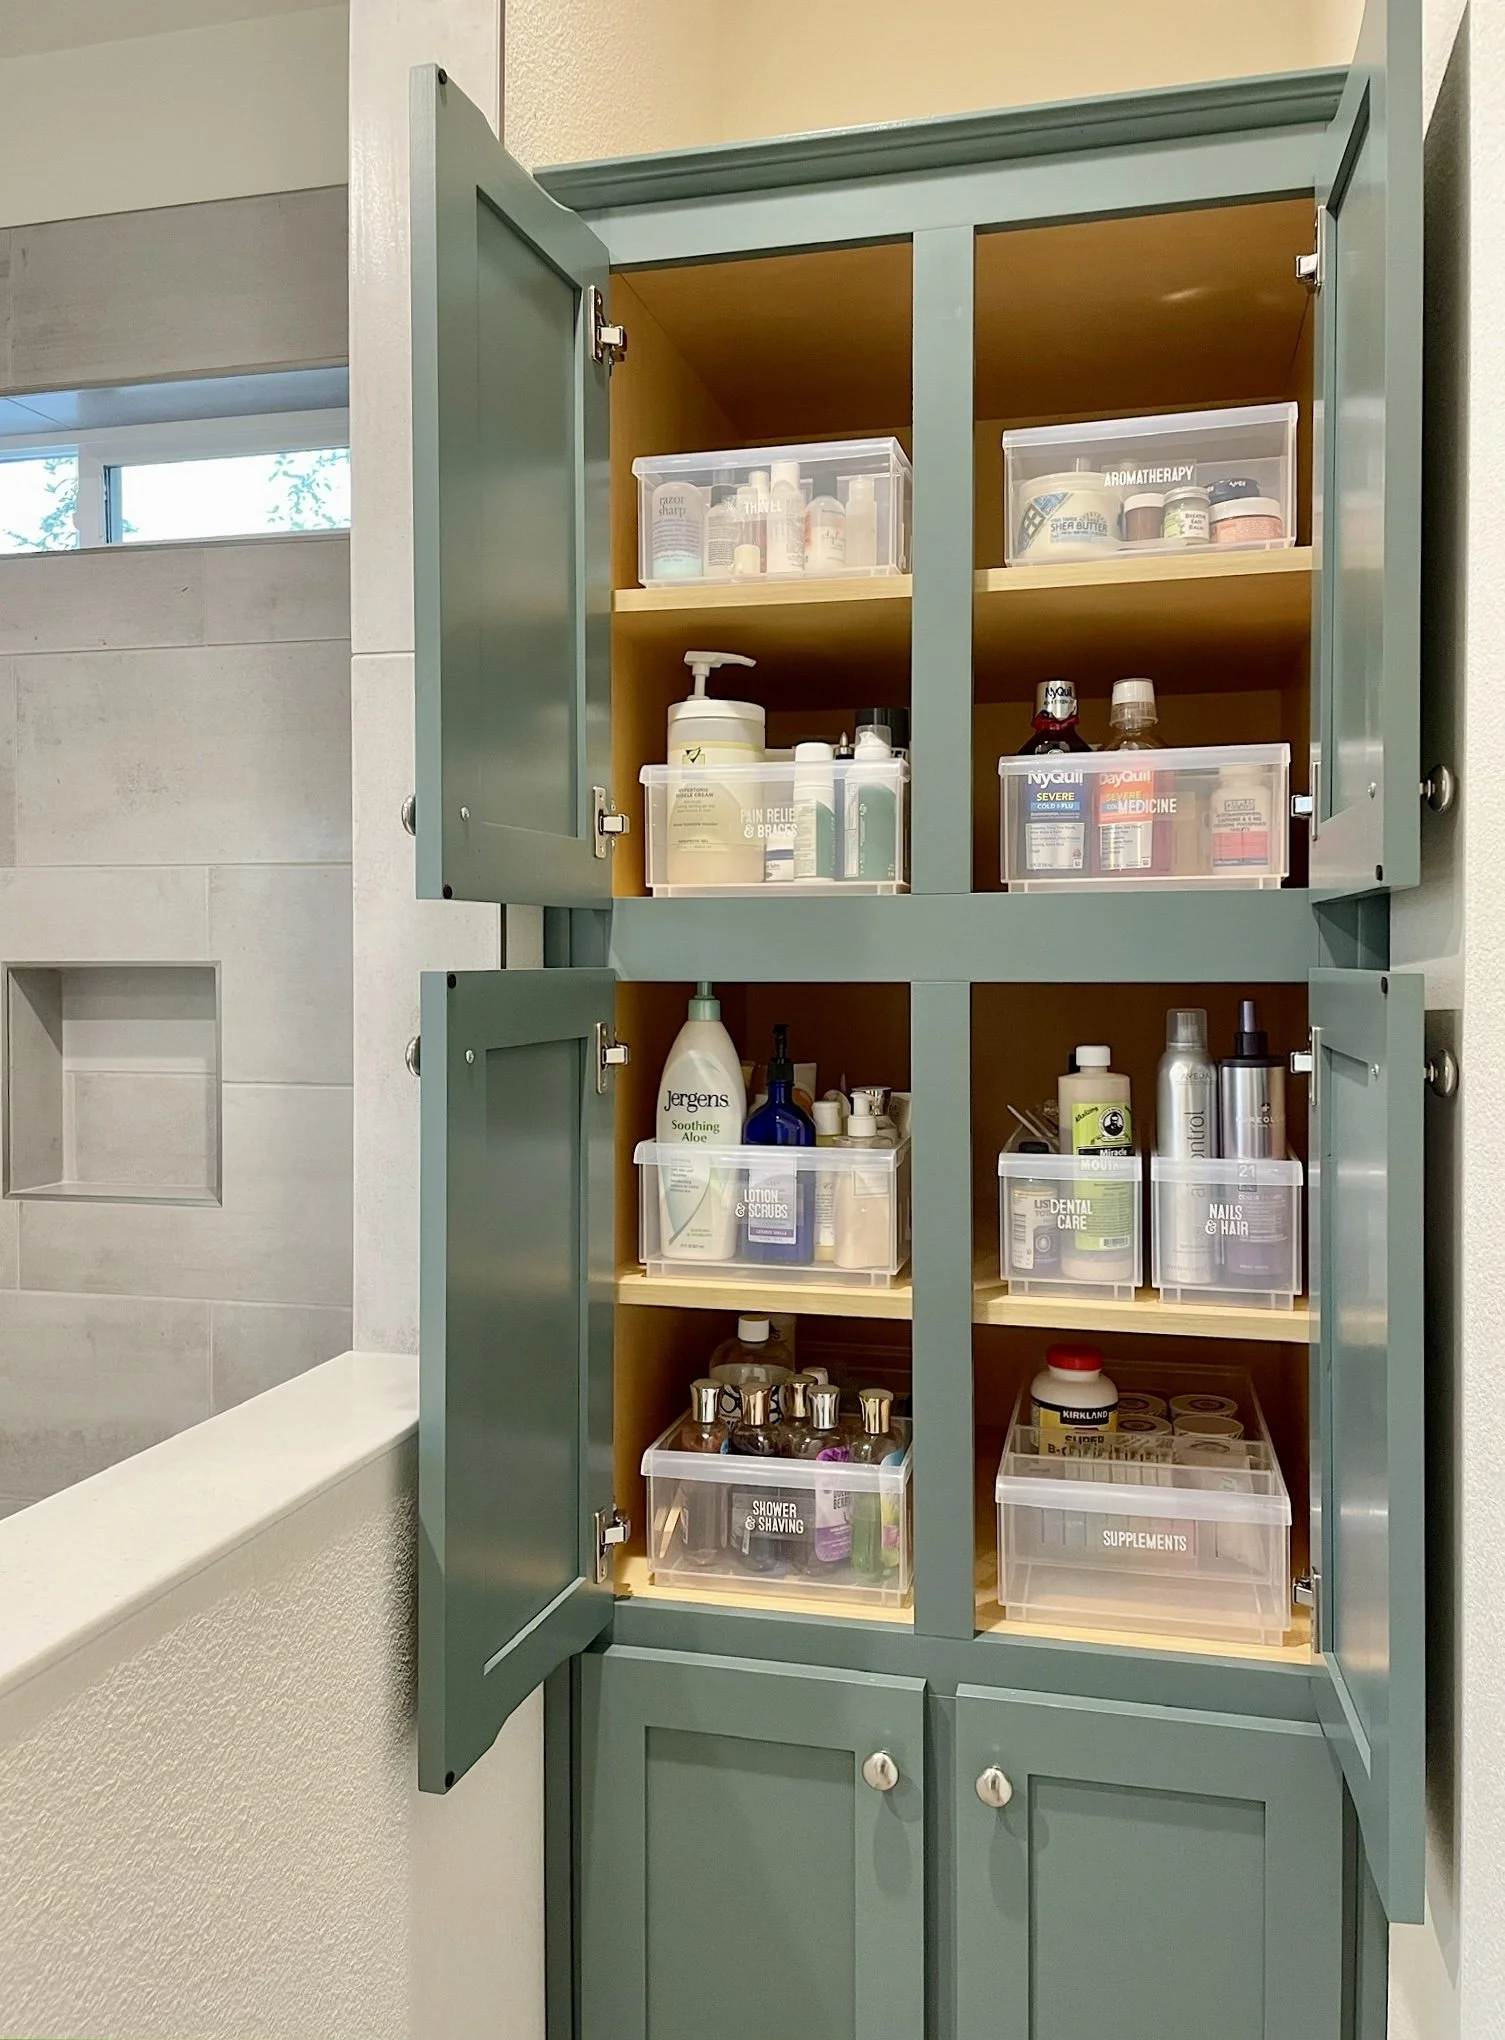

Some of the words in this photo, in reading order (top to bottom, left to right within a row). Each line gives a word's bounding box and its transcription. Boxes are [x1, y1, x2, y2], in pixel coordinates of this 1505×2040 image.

[1103, 465, 1194, 488] AROMATHERAPY
[659, 496, 686, 506] razor
[658, 505, 686, 518] sharp
[1050, 521, 1074, 532] SHEA
[1076, 521, 1107, 532] BUTTER
[1045, 686, 1072, 699] NyQuil
[1036, 792, 1075, 802] SEVERE
[1118, 798, 1177, 814] MEDICINE
[740, 808, 763, 824] PAIN
[766, 807, 796, 823] RELIE
[743, 823, 755, 839] &
[757, 823, 798, 838] BRACES
[664, 1090, 729, 1113] Jergens
[671, 1119, 720, 1135] Soothing
[1184, 1107, 1206, 1159] ontrol
[682, 1132, 707, 1143] Aloe
[1239, 1165, 1256, 1178] 21
[743, 1188, 779, 1204] LOTION
[734, 1202, 746, 1217] &
[748, 1203, 788, 1219] SCRUBS
[1050, 1198, 1093, 1214] DENTAL
[1209, 1203, 1243, 1221] NAILS
[1057, 1214, 1087, 1230] CARE
[1205, 1219, 1217, 1235] &
[1220, 1220, 1249, 1236] HAIR
[1062, 1410, 1108, 1420] KIRKLAND
[752, 1500, 797, 1518] SHOWER
[745, 1515, 756, 1530] &
[758, 1516, 804, 1534] SHAVING
[1103, 1530, 1187, 1551] SUPPLEMENTS
